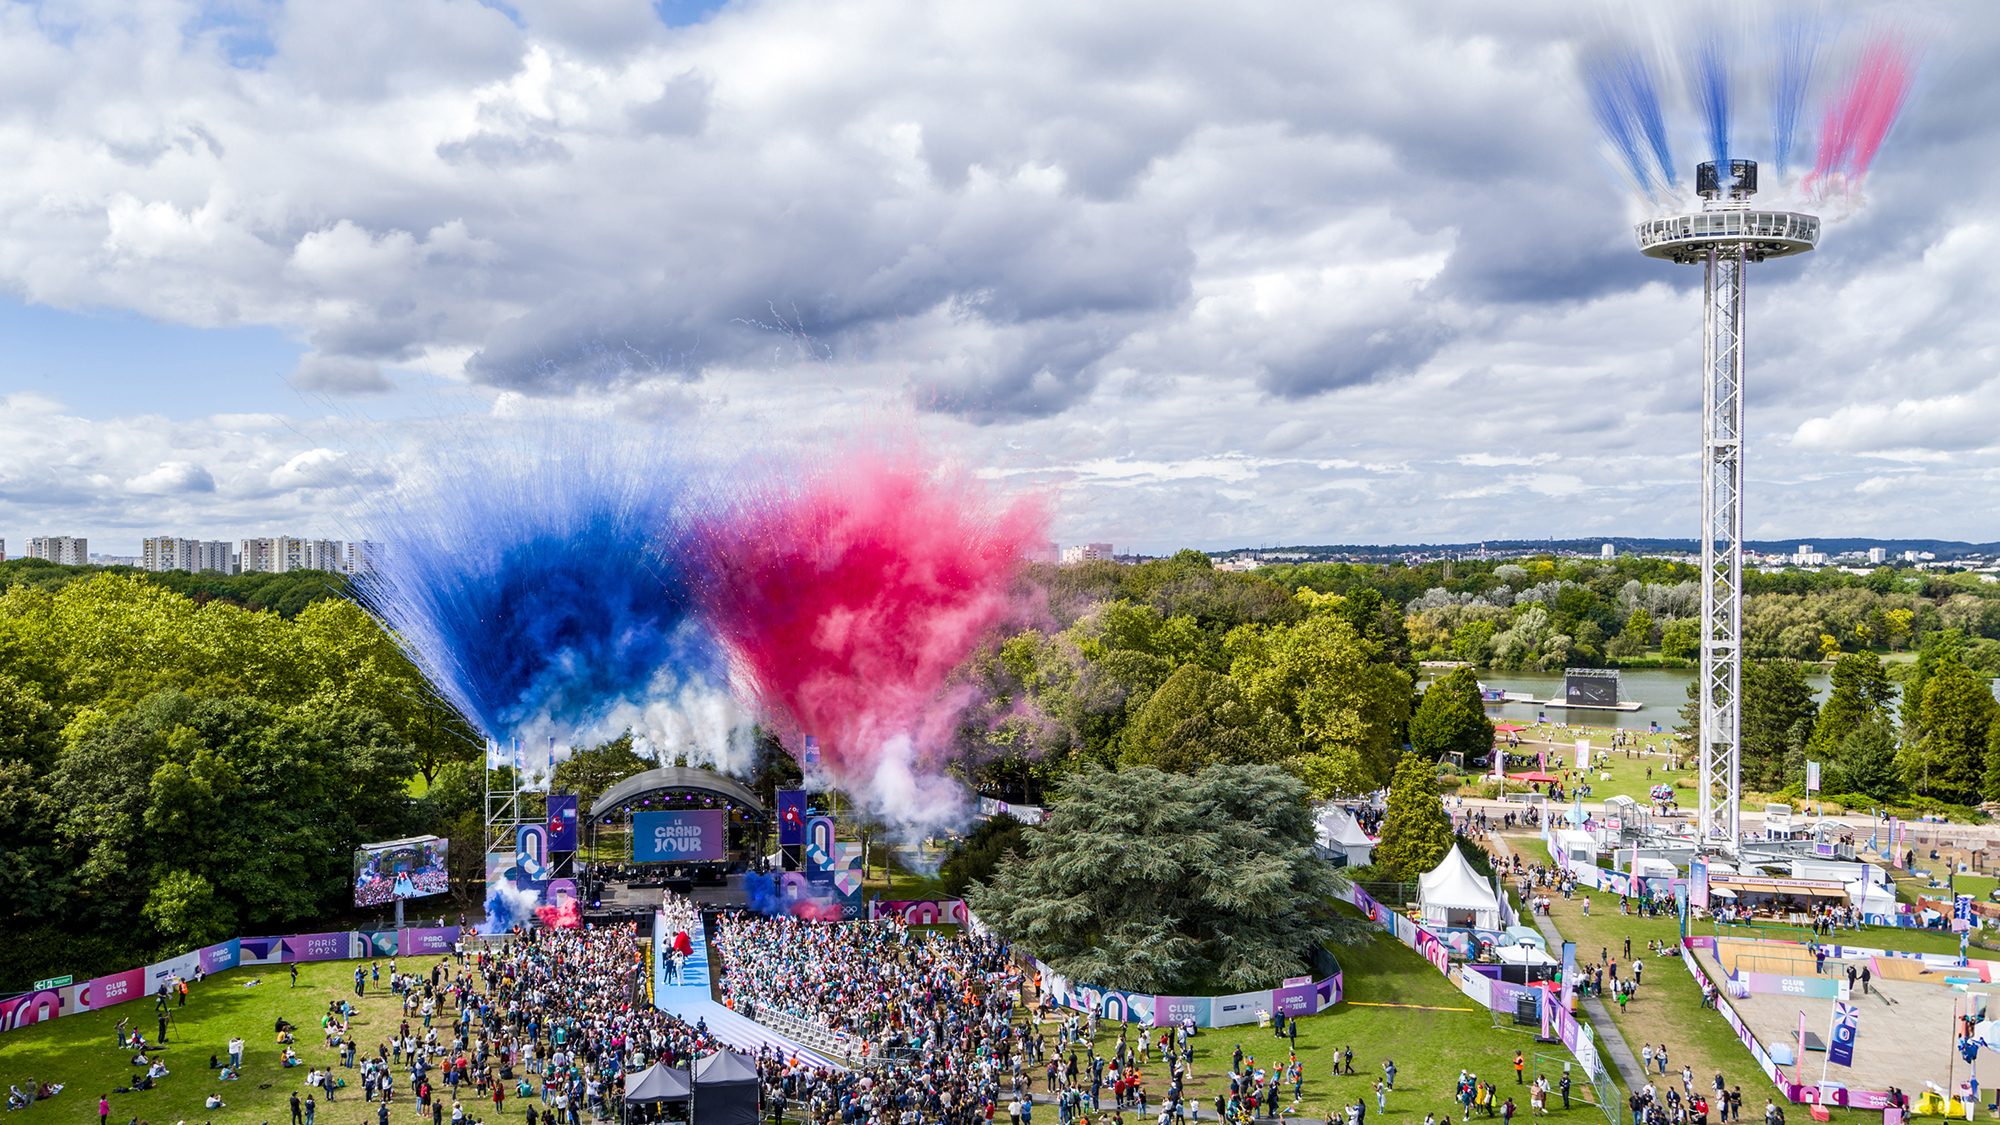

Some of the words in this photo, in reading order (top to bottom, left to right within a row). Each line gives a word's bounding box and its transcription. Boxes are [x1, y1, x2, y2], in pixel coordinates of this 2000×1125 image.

[655, 826, 702, 837] GRAND
[654, 837, 702, 853] JOUR
[308, 938, 337, 948] PARIS
[212, 947, 229, 958] PARC
[308, 947, 337, 955] 2024
[218, 953, 232, 963] JEUX
[105, 980, 127, 991] CLUB
[1782, 985, 1805, 993] 2024
[106, 987, 127, 998] 2024
[1286, 995, 1304, 1004] PARC
[1168, 1004, 1196, 1013] CLUB
[1292, 1002, 1307, 1010] JEUX
[1169, 1013, 1196, 1021] 2024
